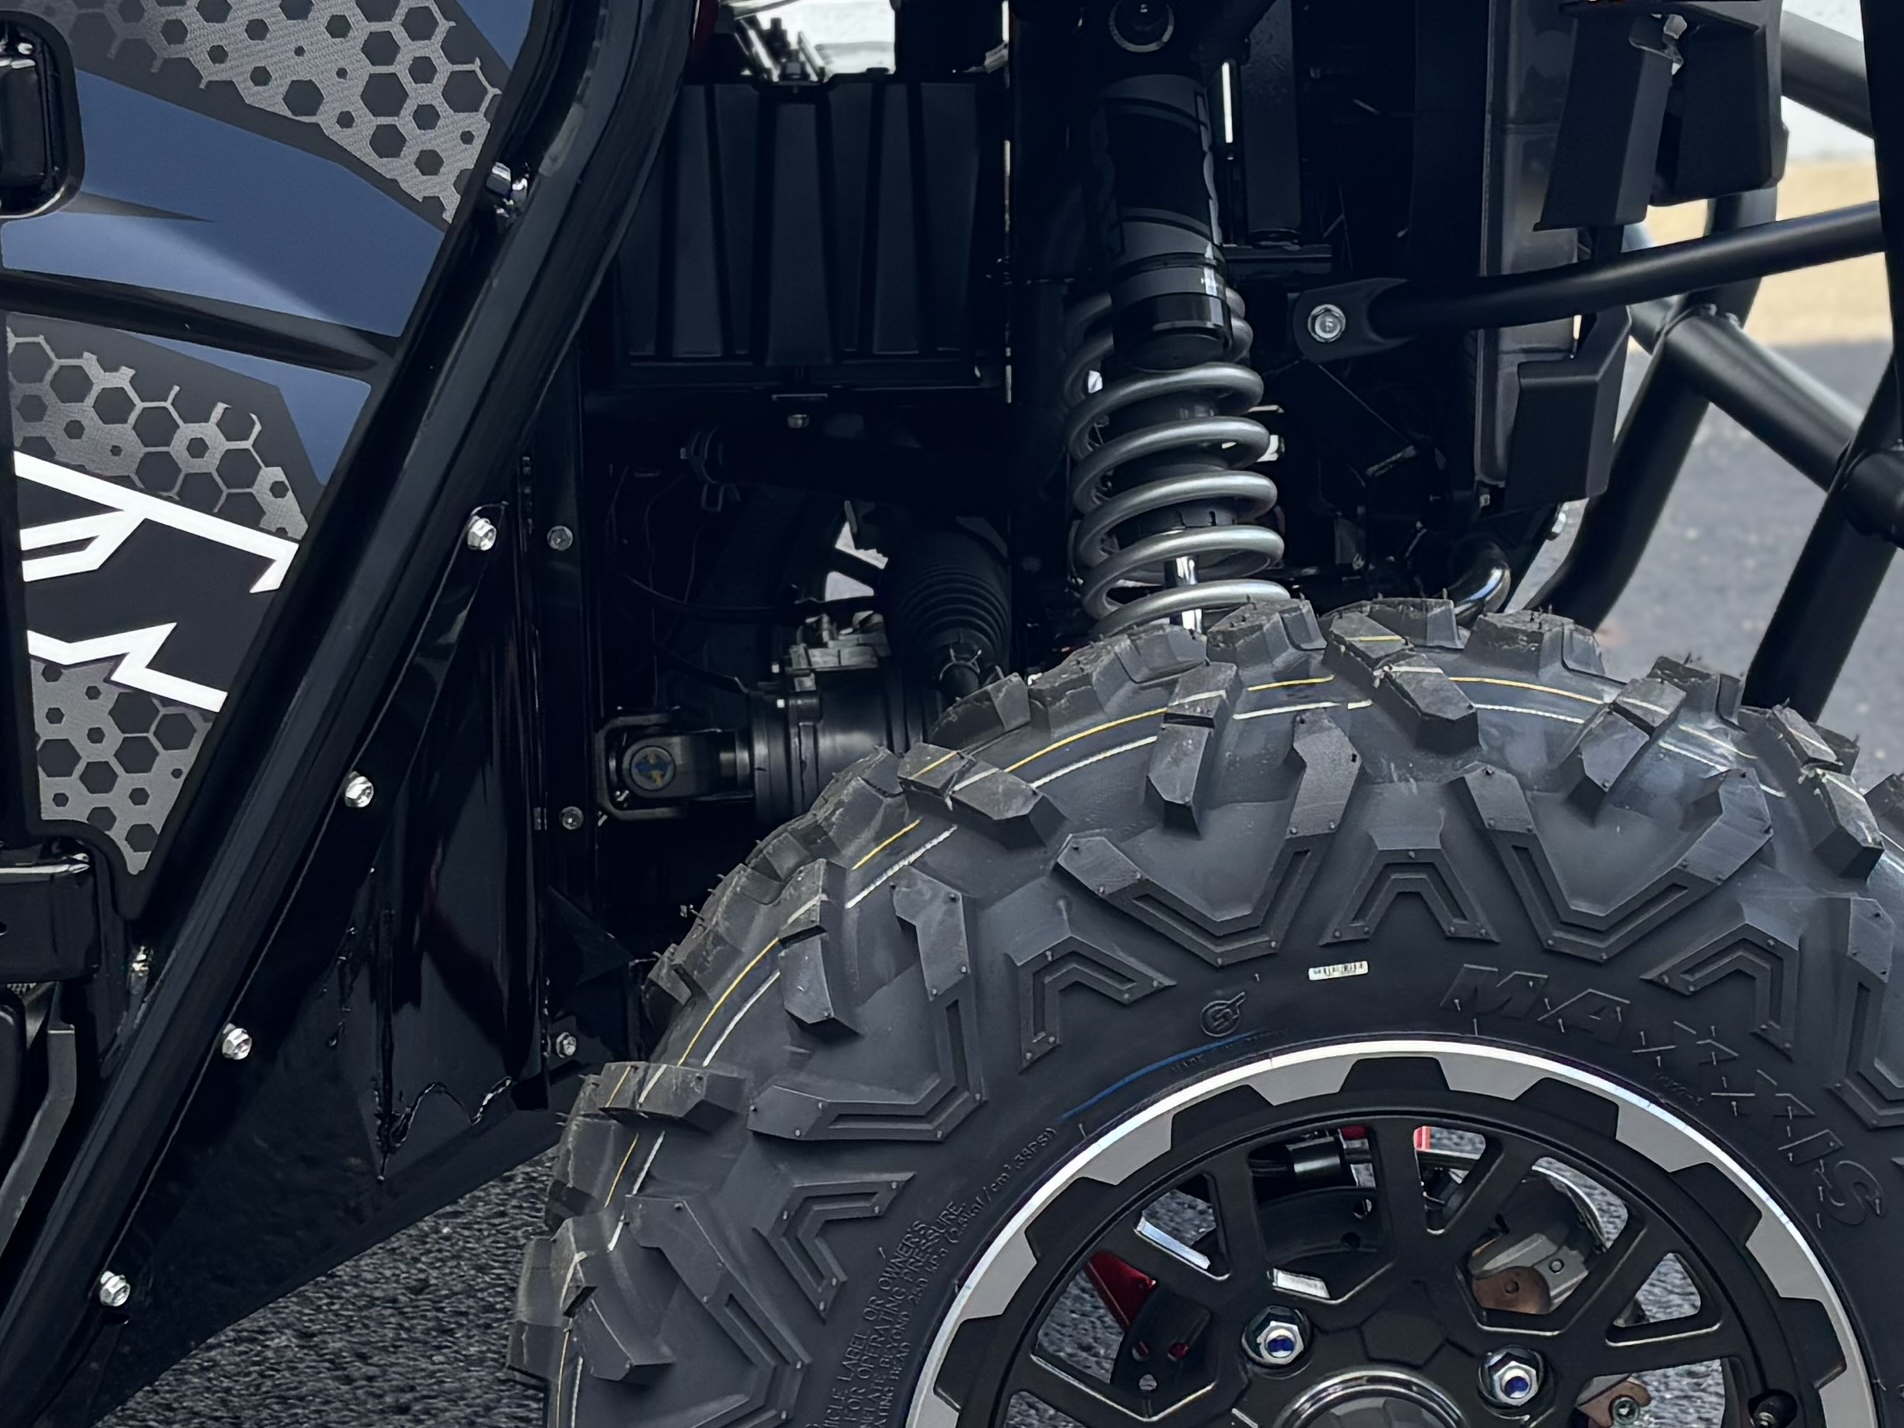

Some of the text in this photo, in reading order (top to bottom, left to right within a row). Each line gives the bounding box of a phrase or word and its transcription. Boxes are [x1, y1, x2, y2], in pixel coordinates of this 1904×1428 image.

[1439, 963, 1886, 1227] MAXXIS
[862, 1297, 885, 1320] OR
[878, 1219, 927, 1288] OWNER'S
[858, 1285, 905, 1379] OPERATING
